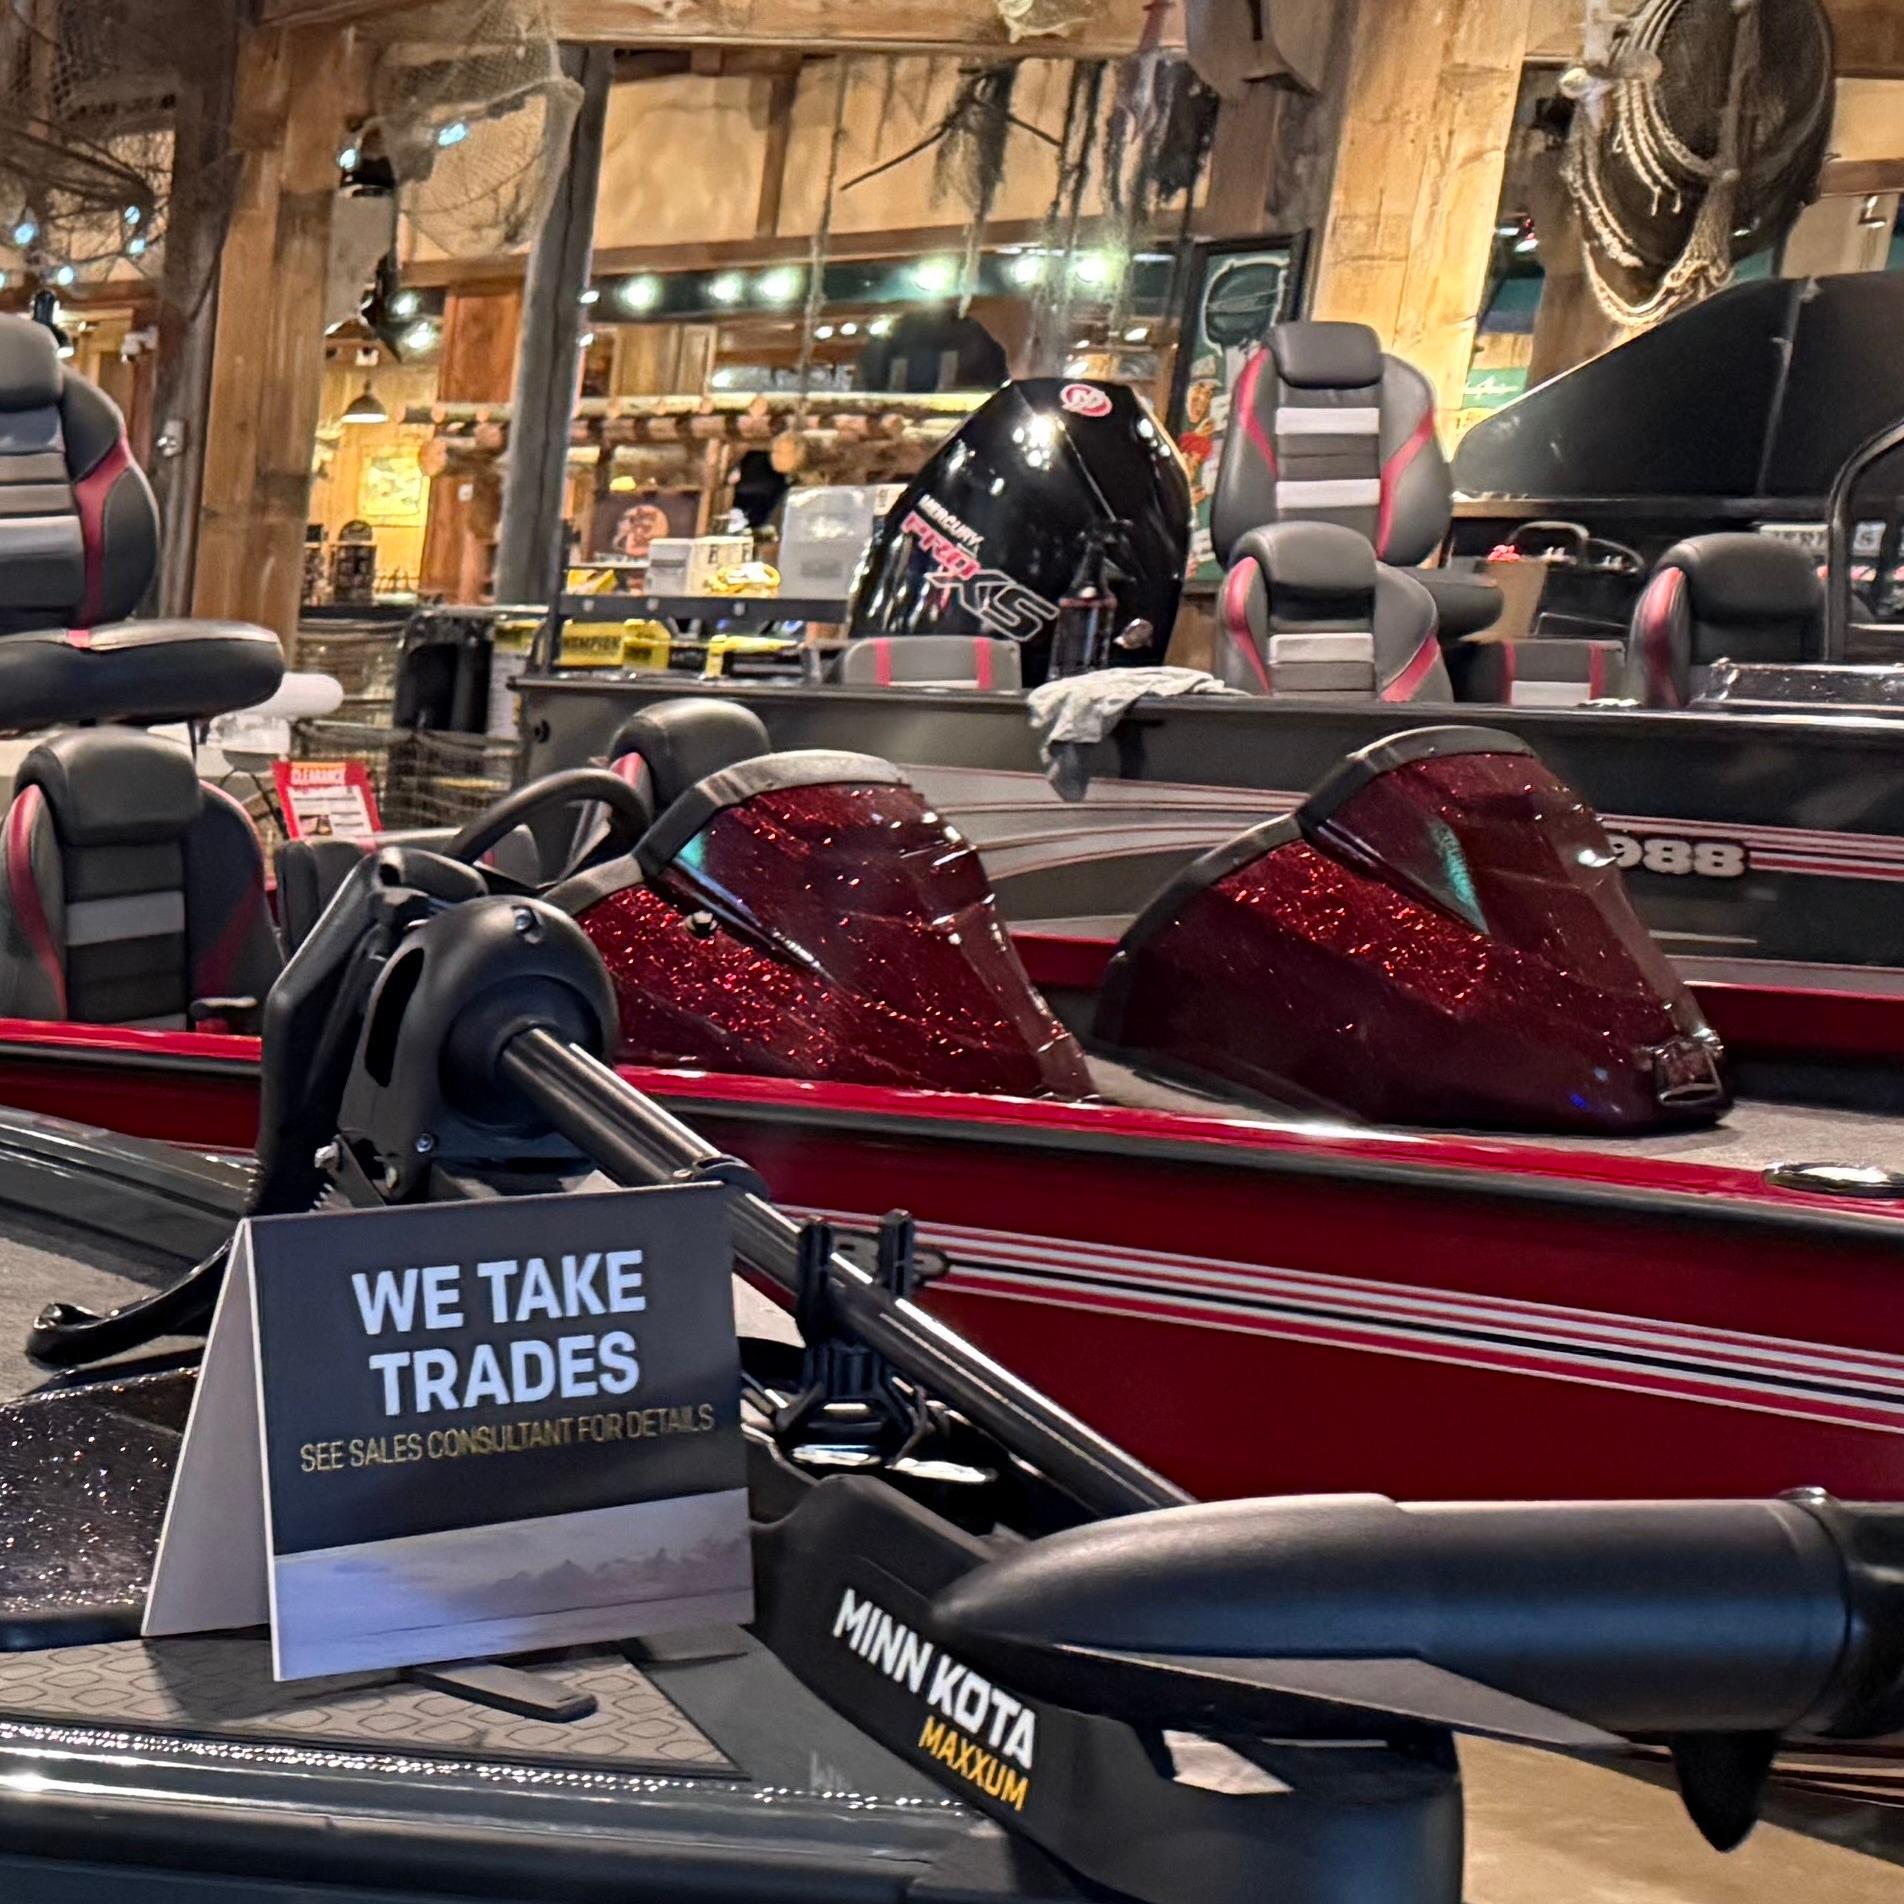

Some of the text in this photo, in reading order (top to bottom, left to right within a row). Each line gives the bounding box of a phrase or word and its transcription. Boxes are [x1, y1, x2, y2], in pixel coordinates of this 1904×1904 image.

[924, 568, 1060, 642] XS
[352, 1250, 646, 1335] WE TAKE
[369, 1331, 640, 1416] TRADES
[300, 1403, 715, 1472] SEE SALES CONSULTANT FOR DETAILS
[833, 1587, 1036, 1770] MINN KOTA
[918, 1714, 1030, 1813] MAXXUM
